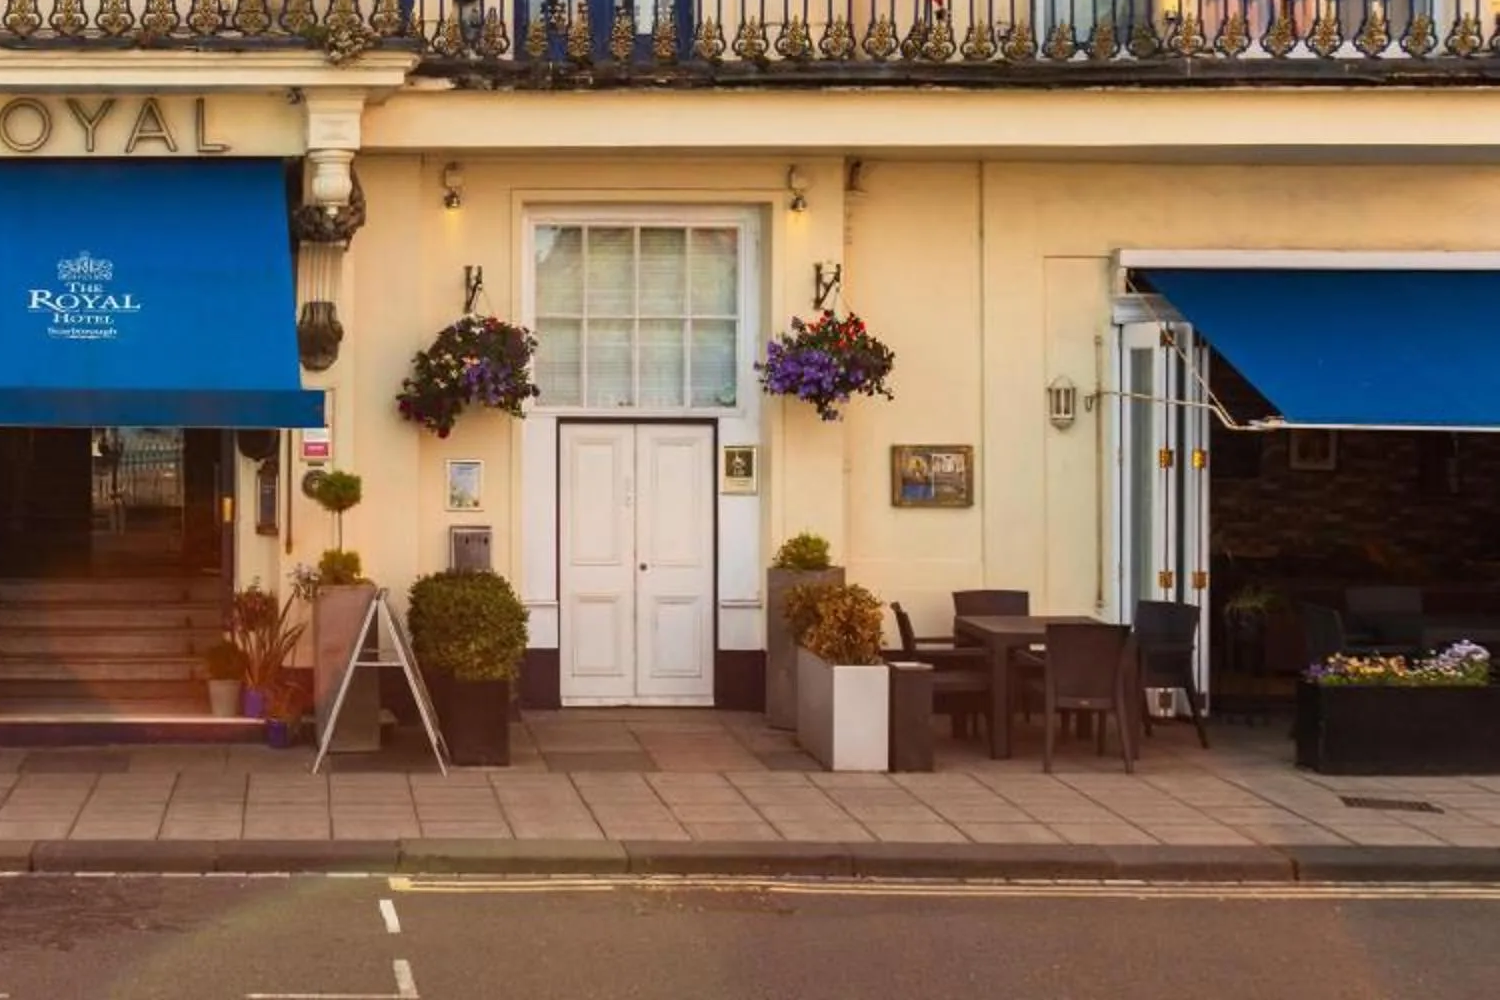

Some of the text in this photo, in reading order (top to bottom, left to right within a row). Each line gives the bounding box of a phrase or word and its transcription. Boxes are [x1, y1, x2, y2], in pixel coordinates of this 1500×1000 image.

[64, 282, 104, 293] THE
[28, 290, 141, 312] ROYAL
[53, 314, 115, 325] HOTEL
